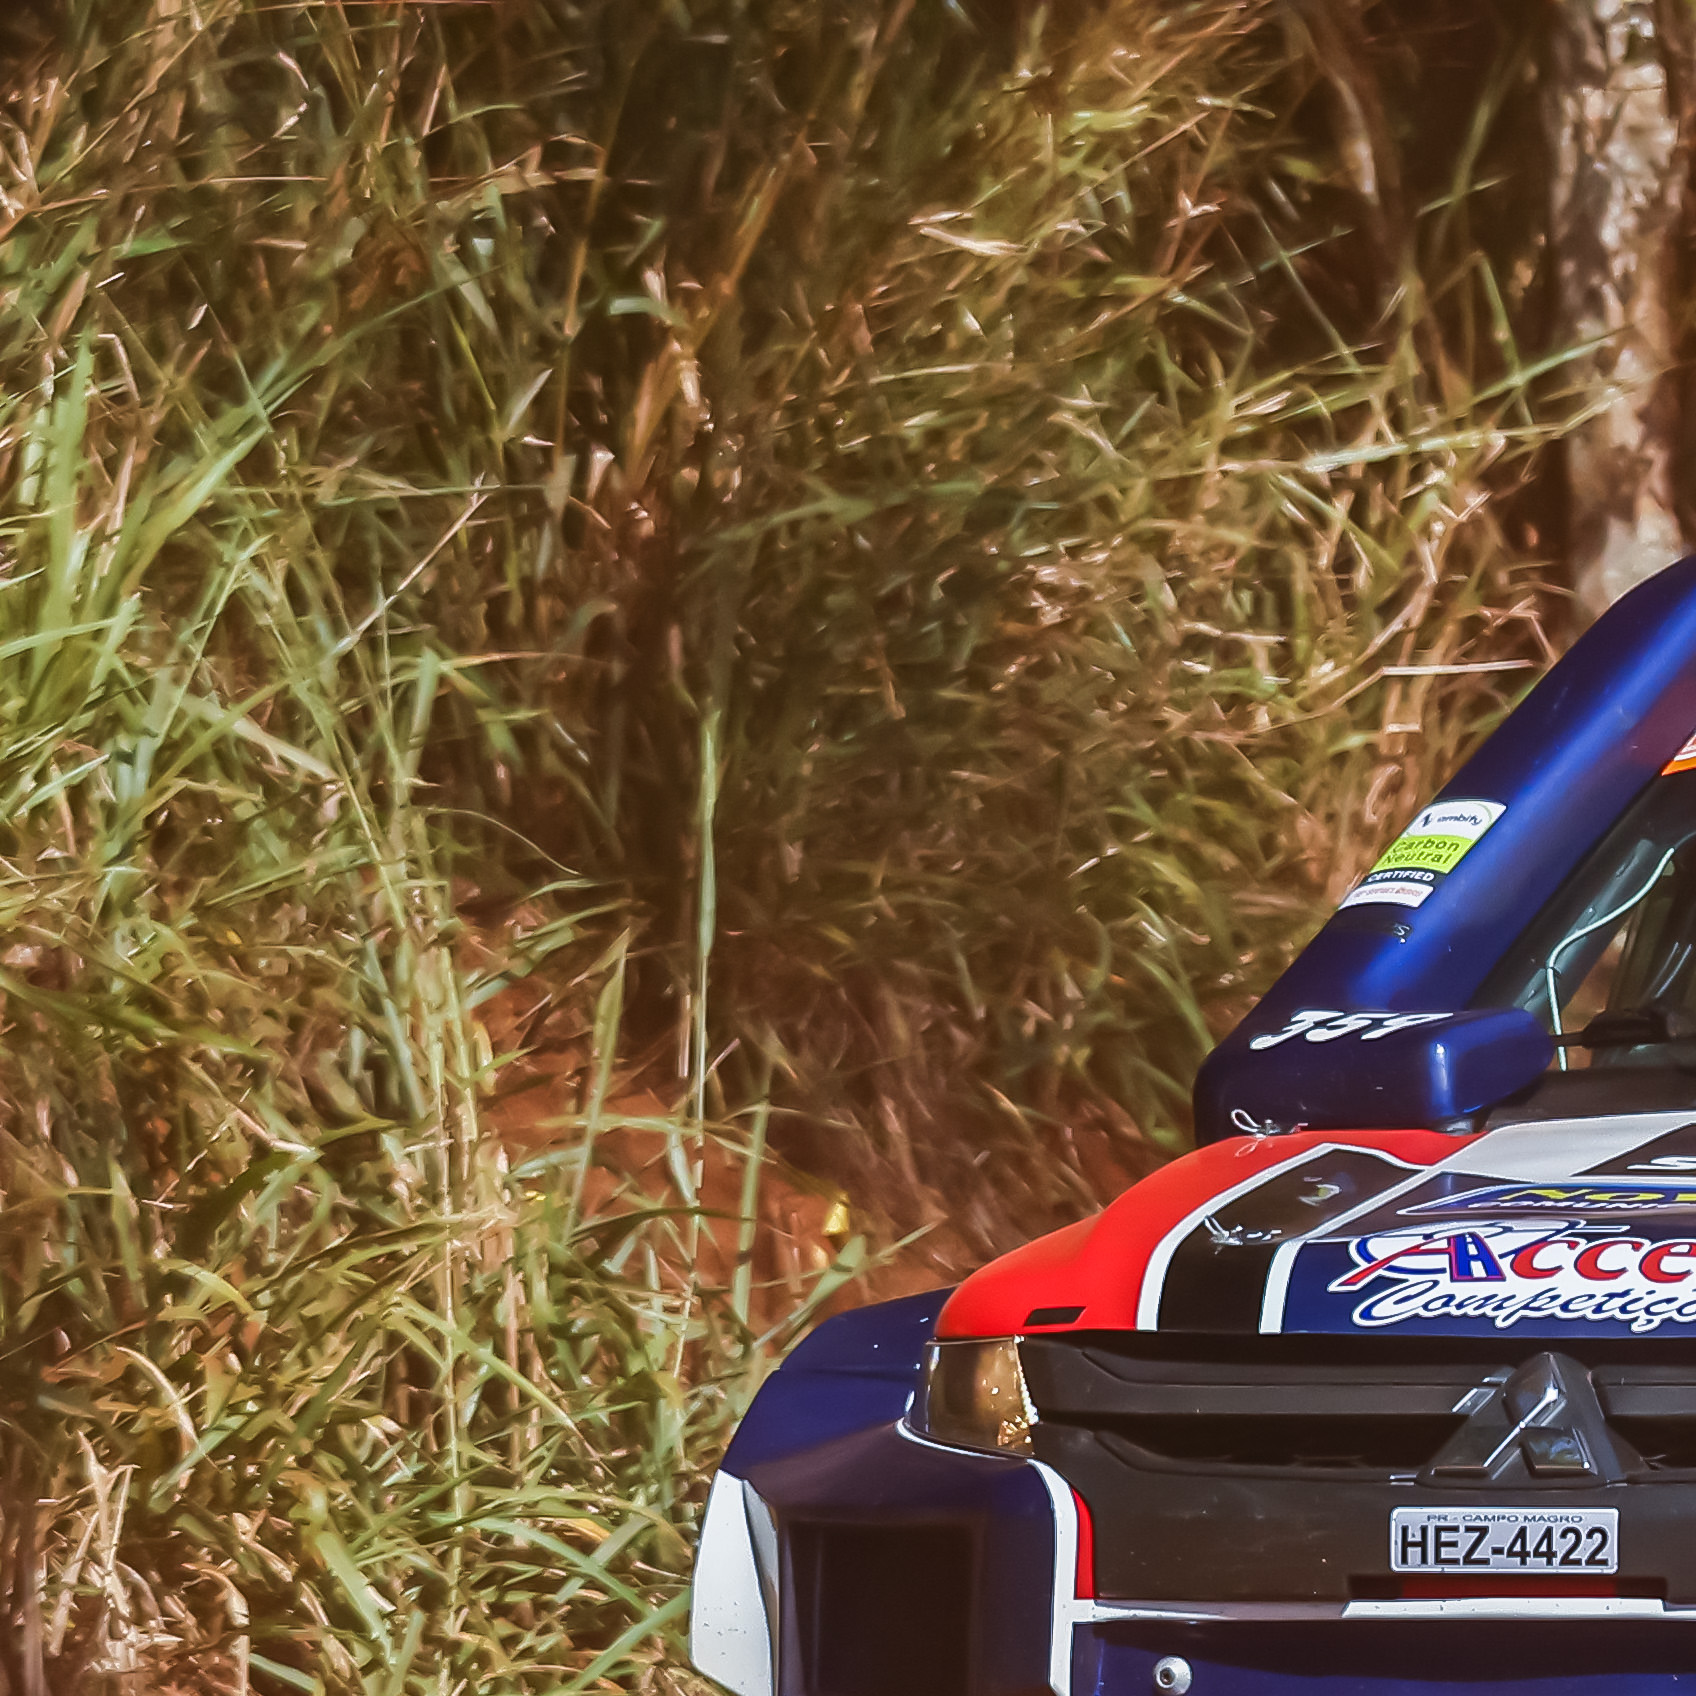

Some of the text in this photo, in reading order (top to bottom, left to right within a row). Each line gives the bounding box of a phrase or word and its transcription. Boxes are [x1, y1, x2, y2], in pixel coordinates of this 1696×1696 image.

[1392, 837, 1460, 853] Carbon
[1382, 850, 1453, 865] Neutral
[1367, 870, 1435, 883] CERTIFIED
[1427, 1514, 1449, 1523] PR
[1462, 1514, 1519, 1523] CAMPO
[1523, 1514, 1584, 1524] MAGRO
[1401, 1524, 1611, 1567] HEZ-4422
